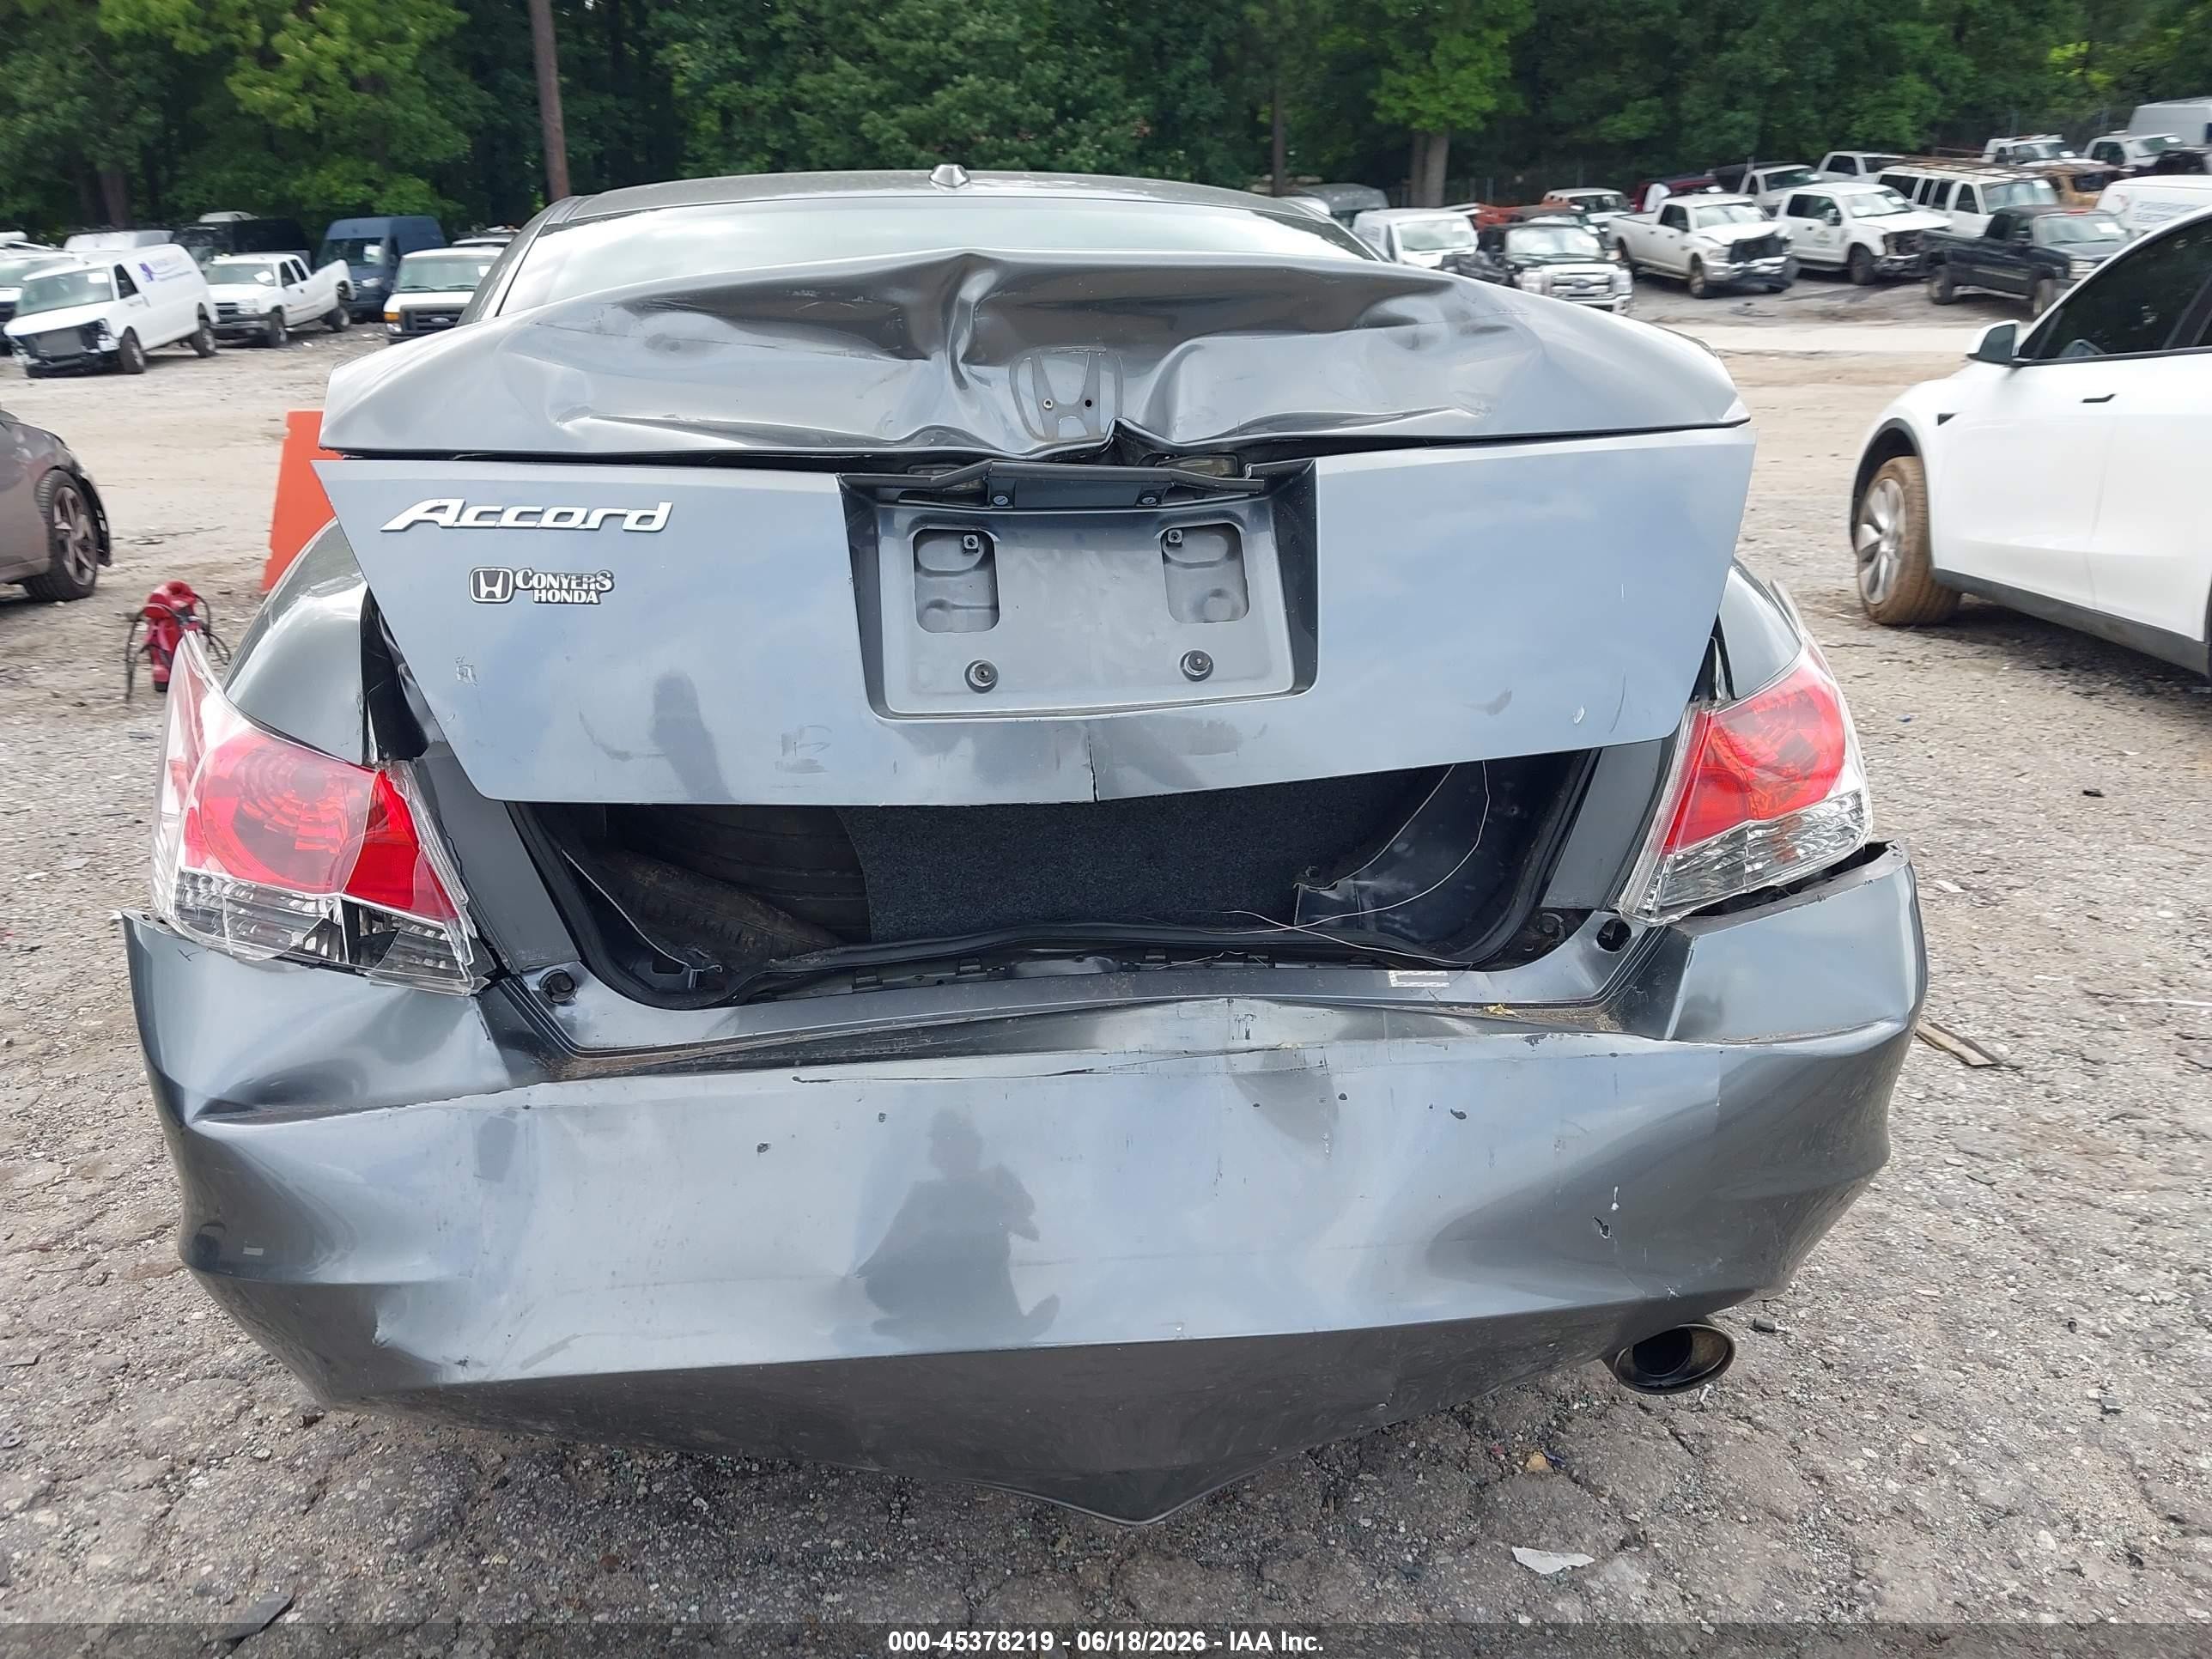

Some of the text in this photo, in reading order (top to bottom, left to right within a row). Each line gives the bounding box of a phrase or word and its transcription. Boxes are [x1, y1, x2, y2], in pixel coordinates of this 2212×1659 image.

[380, 497, 673, 533] Accord
[515, 568, 613, 591] CONYERS
[533, 589, 599, 604] HONDA
